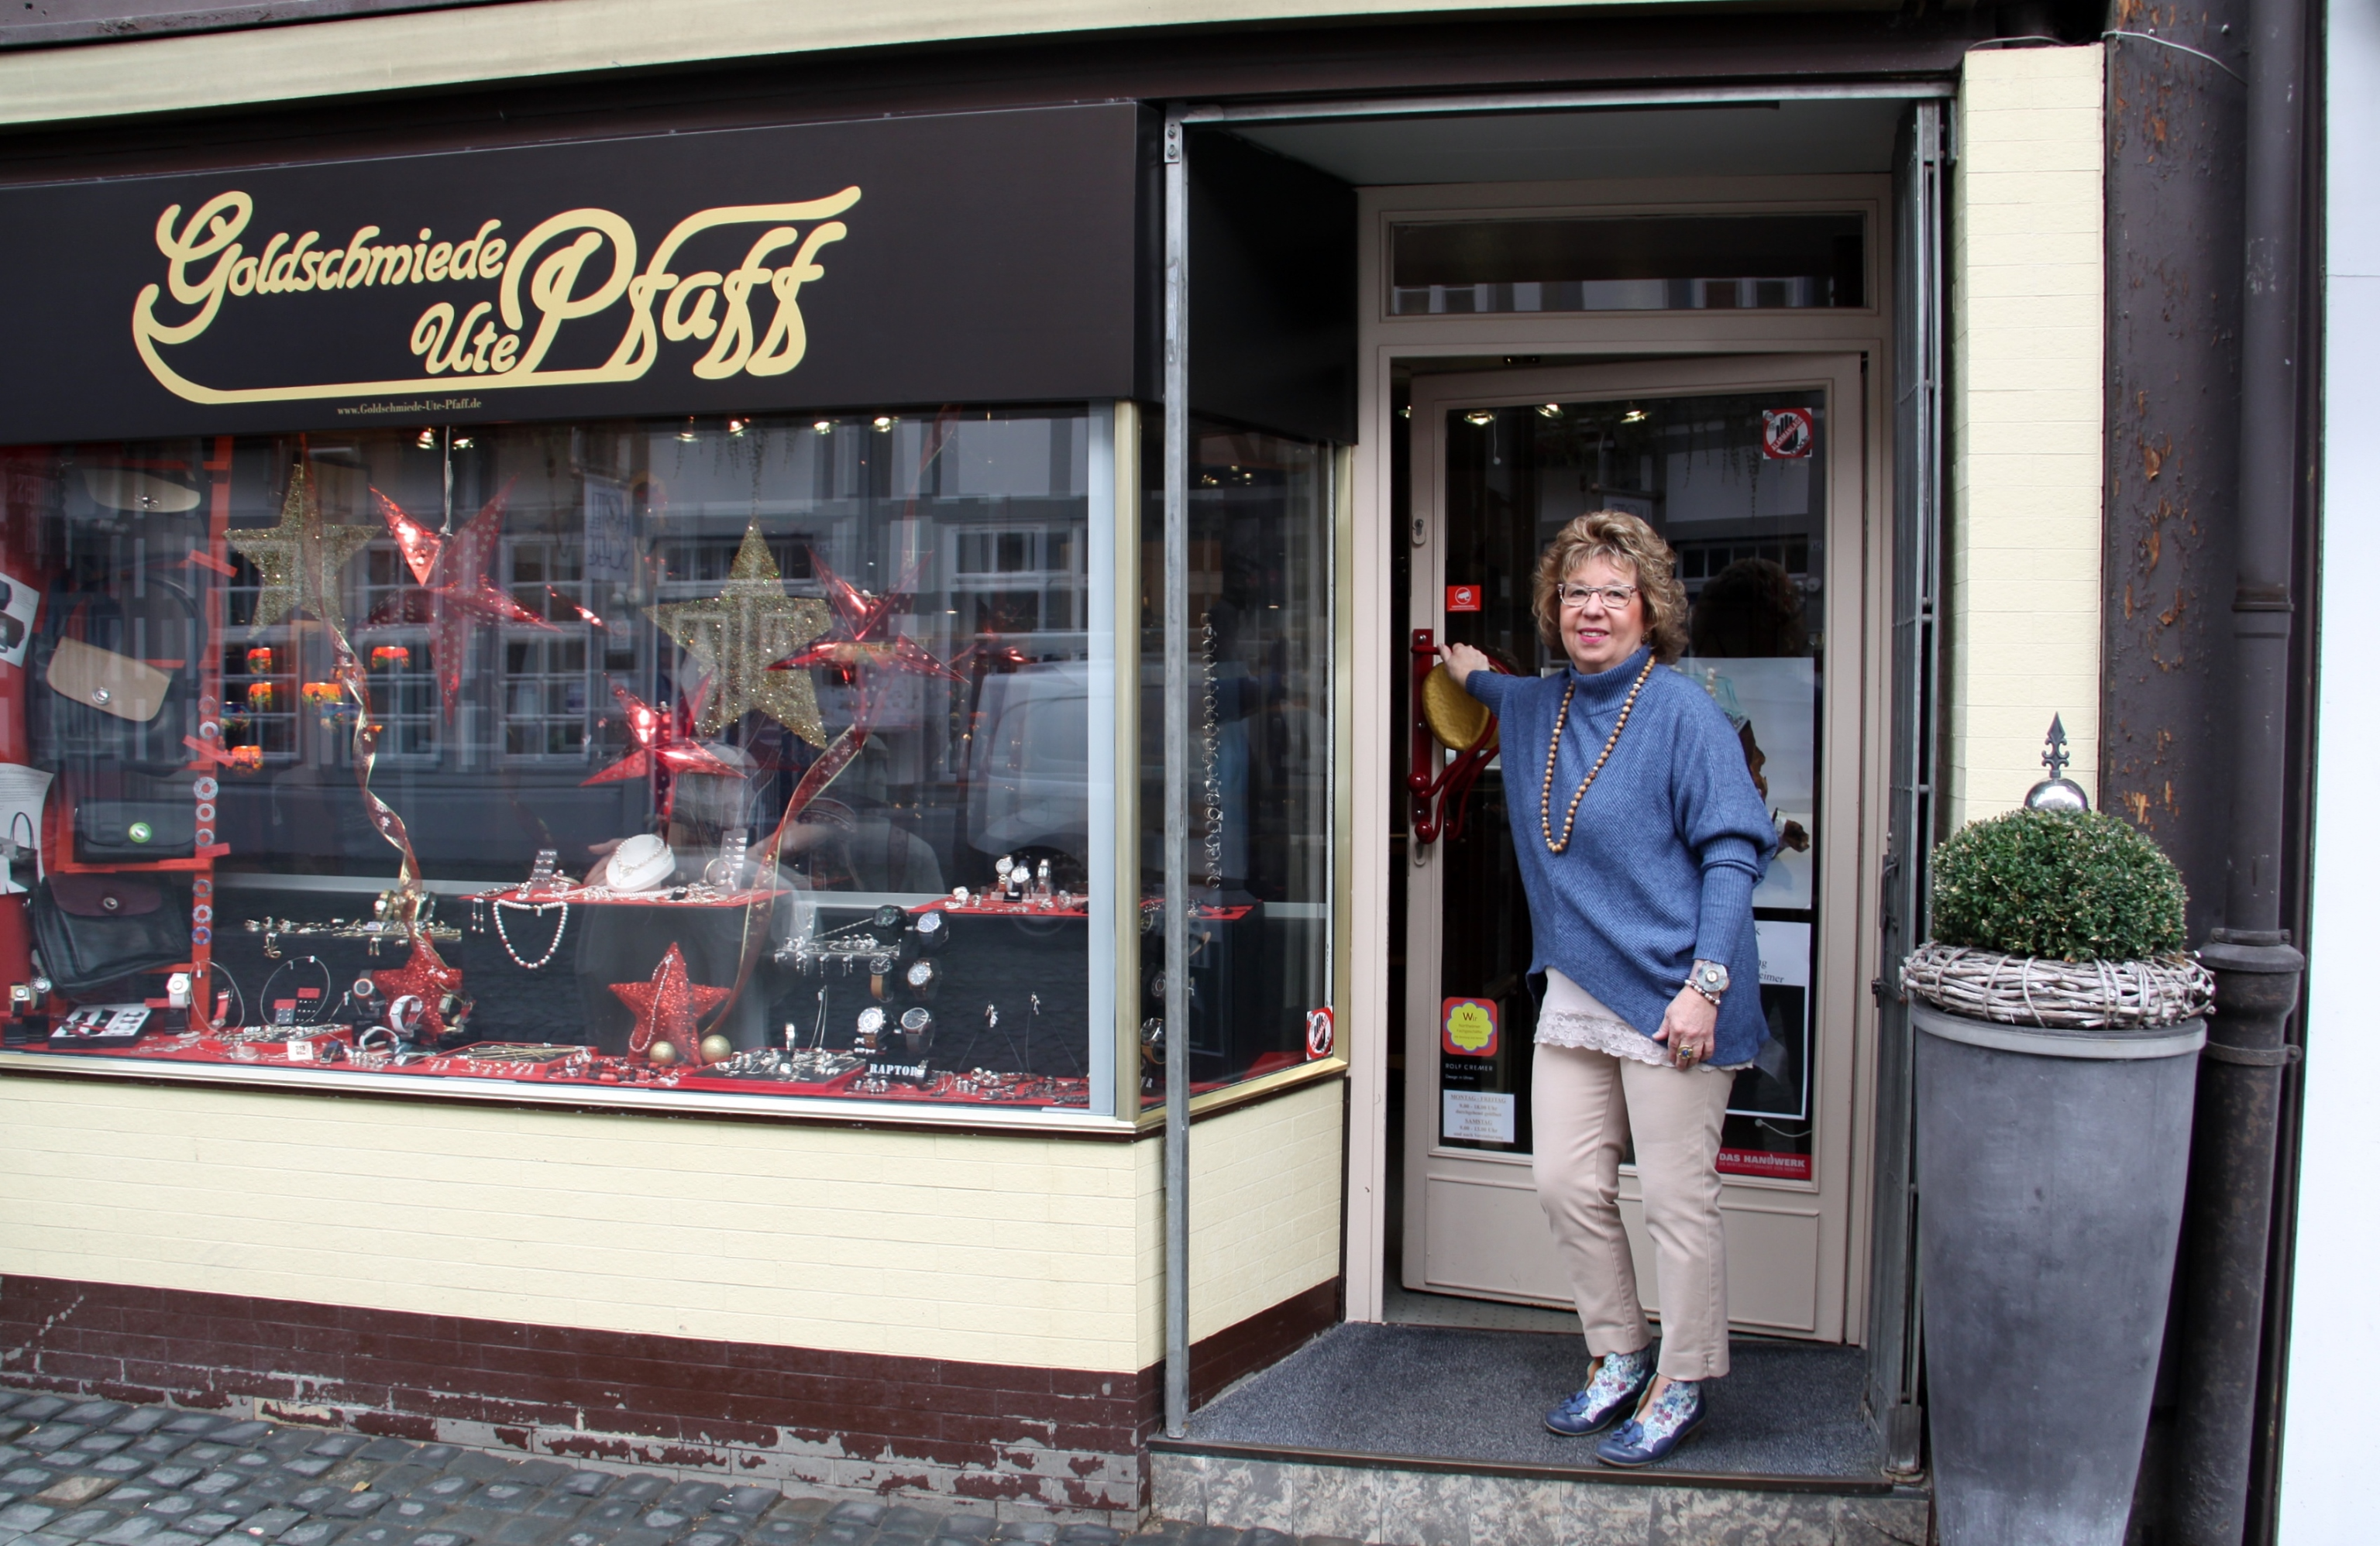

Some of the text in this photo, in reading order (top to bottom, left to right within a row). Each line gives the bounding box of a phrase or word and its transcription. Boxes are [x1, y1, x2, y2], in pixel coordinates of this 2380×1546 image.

[133, 185, 862, 385] Goldschmiede Pfaff
[411, 301, 521, 374] Ute
[337, 397, 482, 415] www.Goldschmiede-Ute-Pfaff.de
[1770, 415, 1804, 451] ALARMANLAGE
[1759, 971, 1784, 983] eimer
[1462, 1012, 1478, 1022] Wir
[869, 1063, 917, 1077] RAPTOR
[1718, 1153, 1805, 1167] DAS HANDWERK
